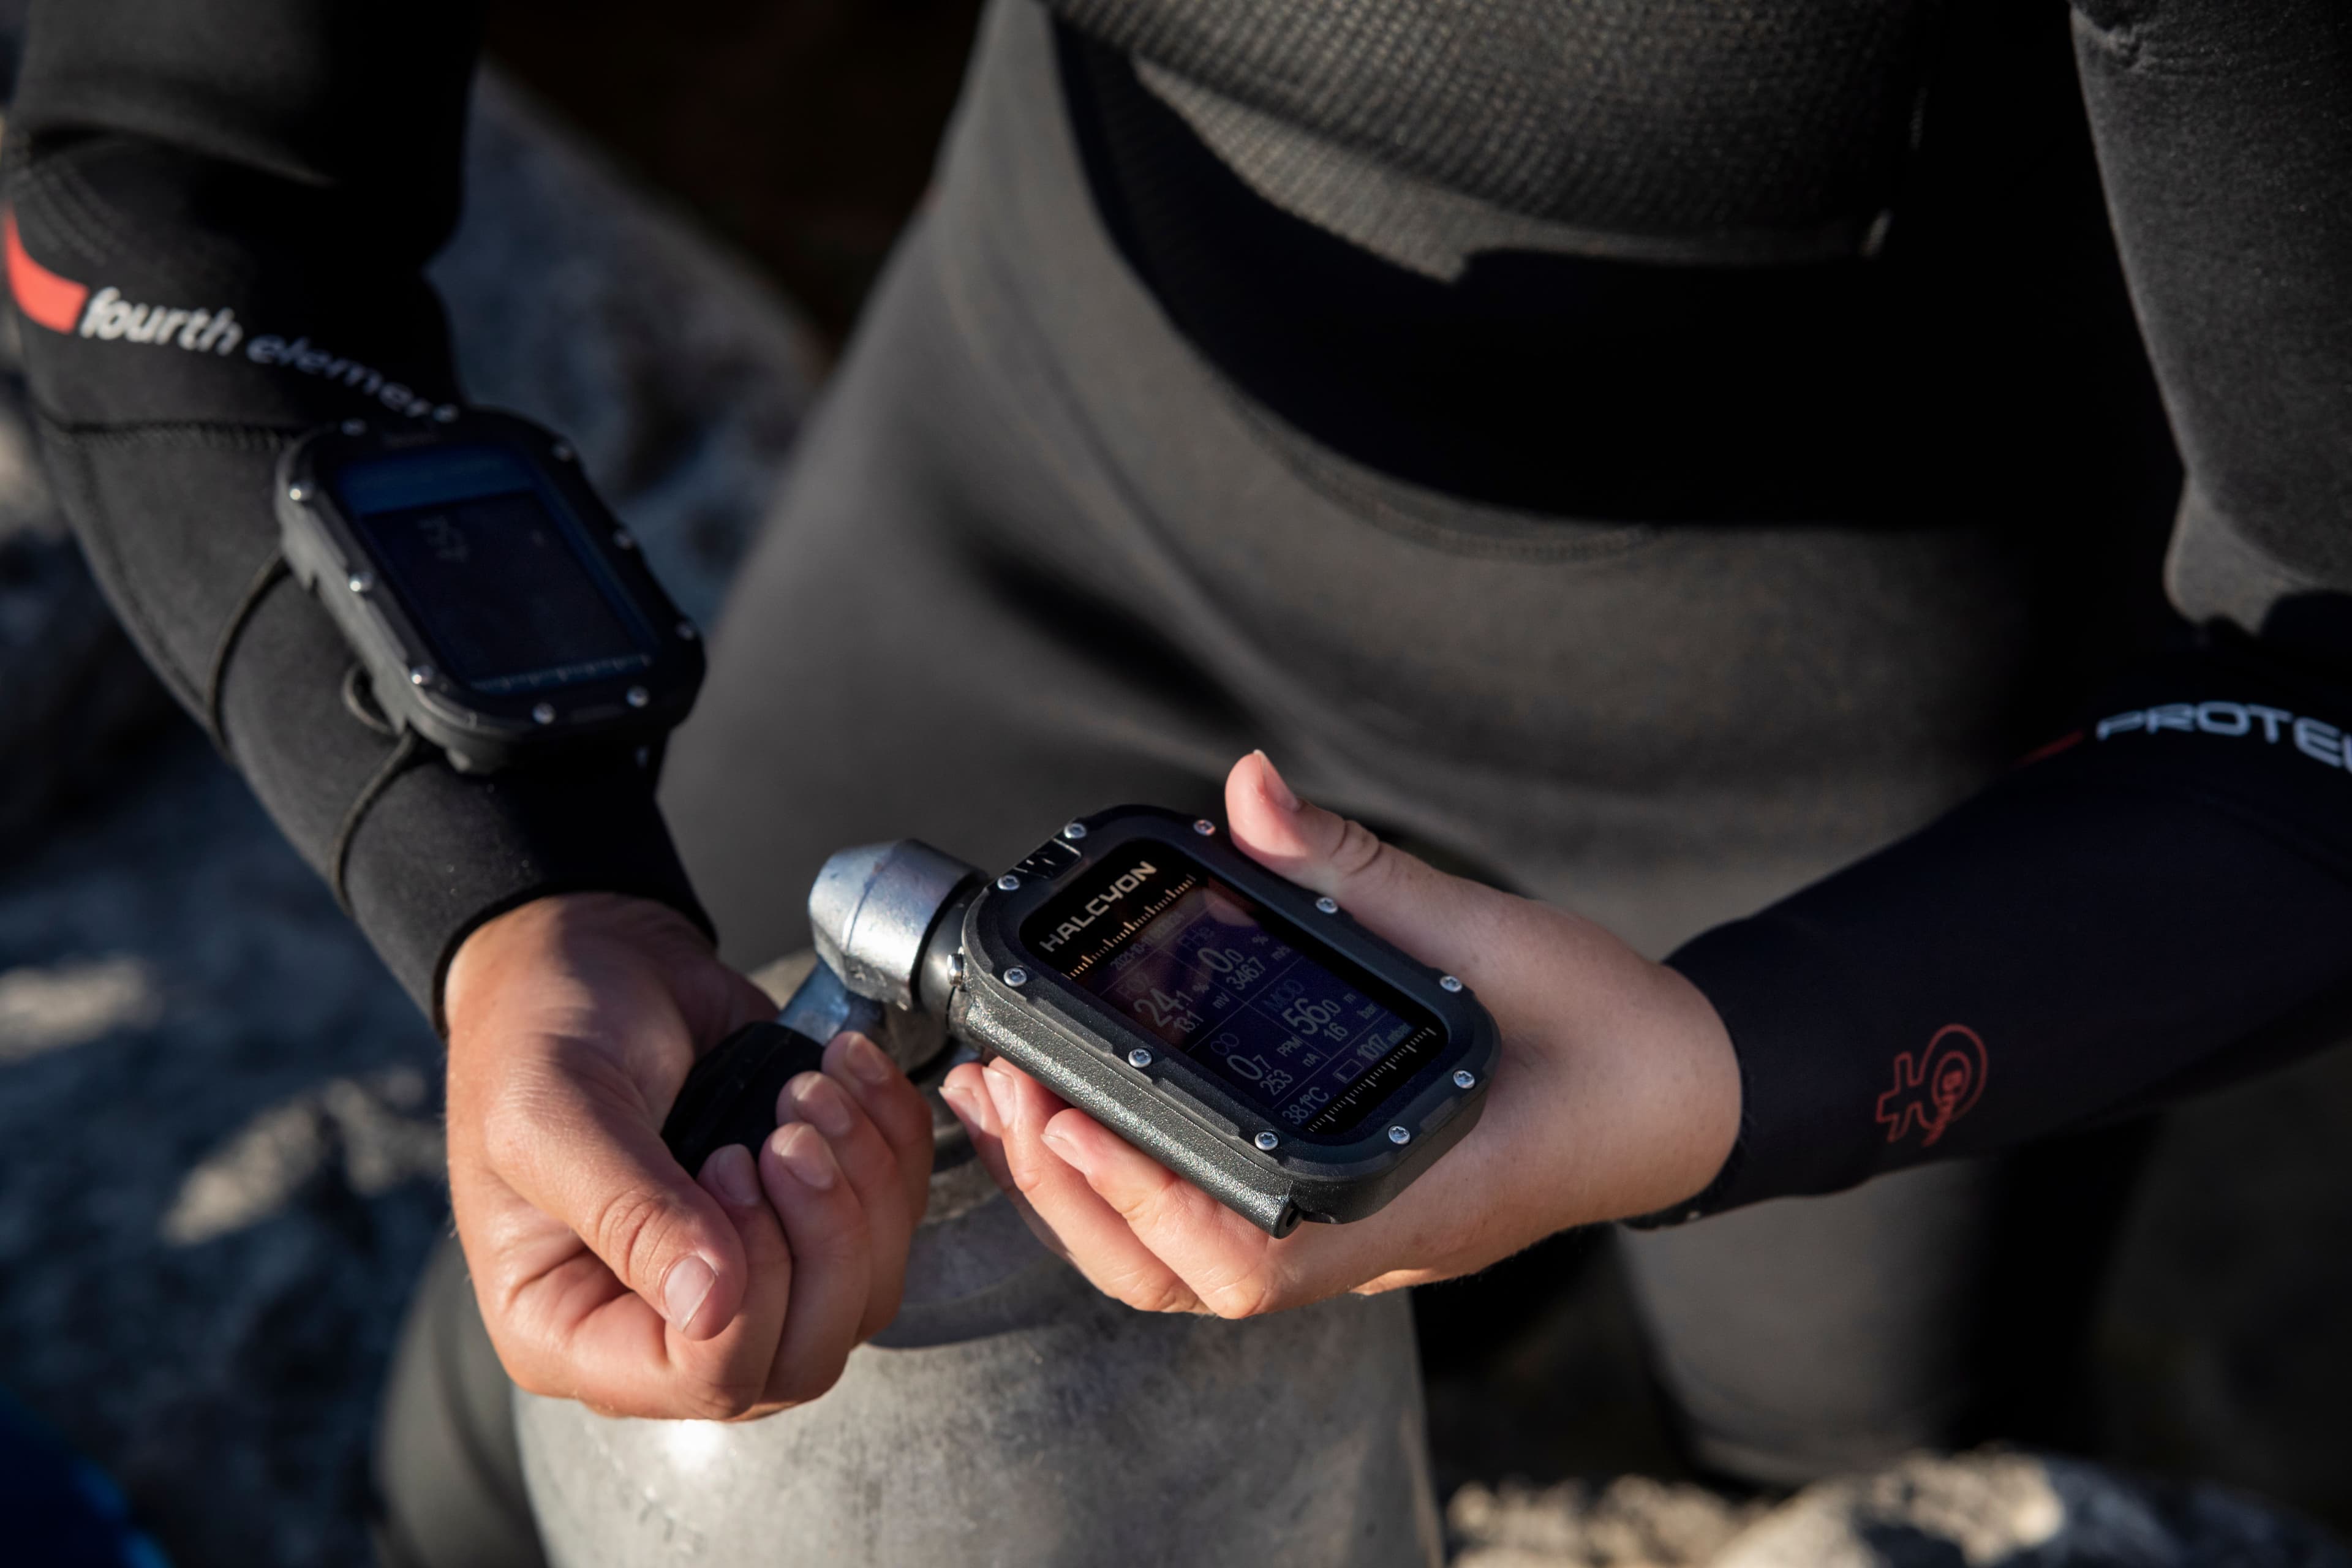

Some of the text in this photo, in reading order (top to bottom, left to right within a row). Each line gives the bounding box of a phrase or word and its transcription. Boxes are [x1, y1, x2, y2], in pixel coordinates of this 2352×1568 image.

[80, 285, 431, 420] fourth eleme
[2095, 700, 2352, 774] PROTE
[1039, 861, 1157, 952] HALCYON
[1259, 1069, 1294, 1096] 253
